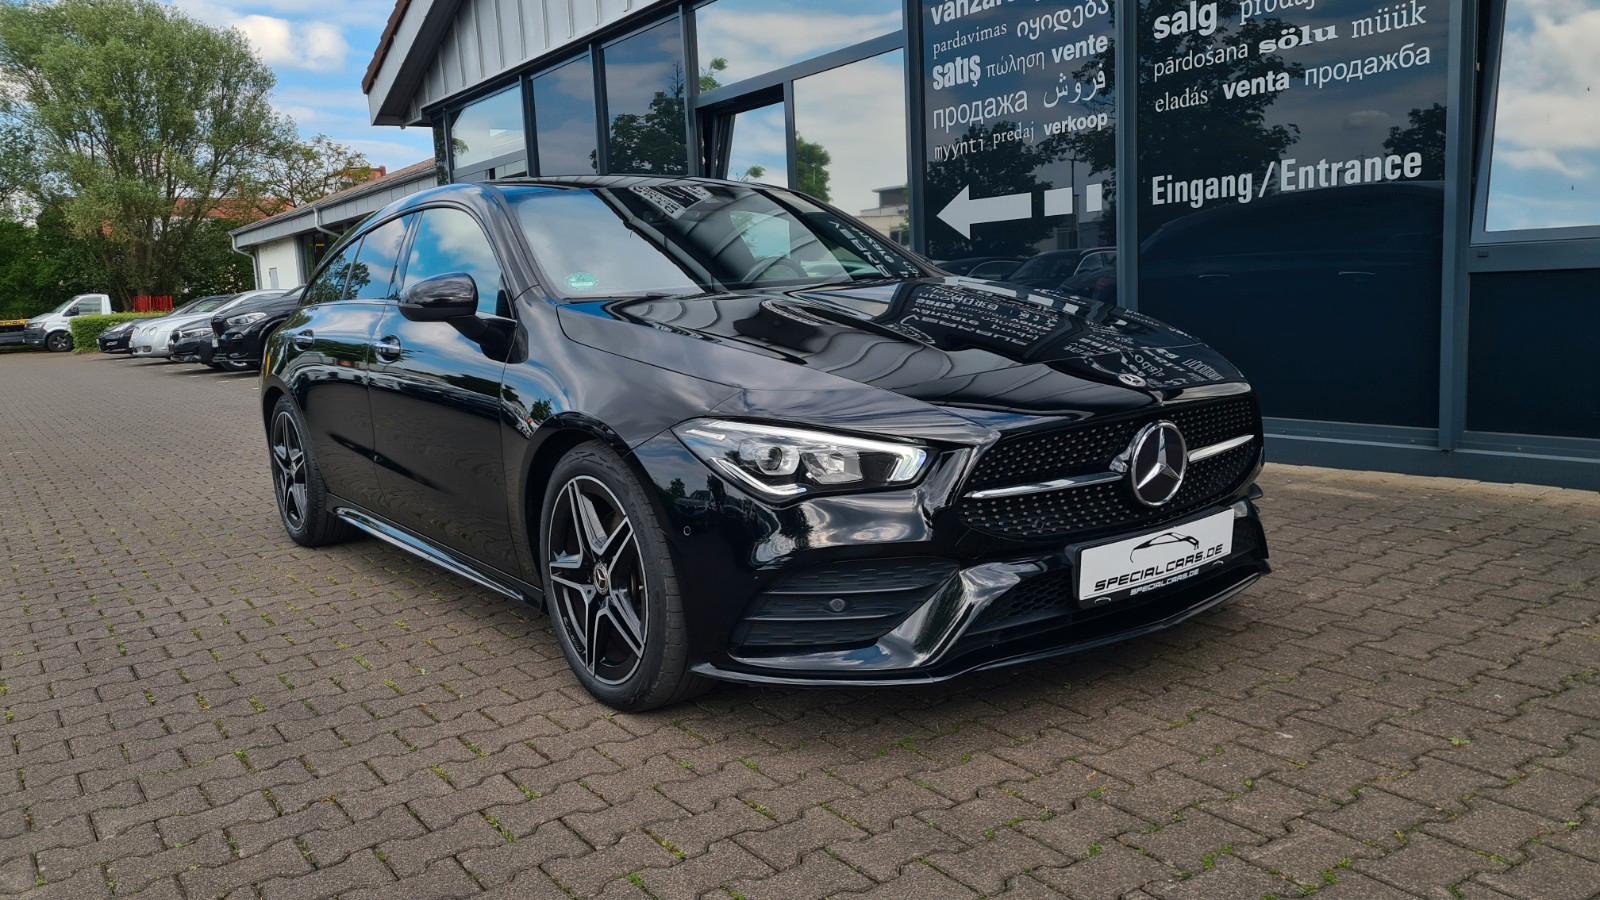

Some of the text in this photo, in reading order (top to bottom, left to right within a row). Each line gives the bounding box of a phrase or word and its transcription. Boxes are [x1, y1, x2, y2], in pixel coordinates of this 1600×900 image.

[933, 23, 1007, 59] pardavimas
[1153, 1, 1217, 39] salg
[1154, 0, 1426, 82] pārdošana sölu müük
[932, 35, 1108, 90] satış πώληση vente
[1155, 43, 1430, 112] eladás venta продажба
[933, 90, 1028, 133] продажа
[934, 112, 1108, 162] myynti predaj verkoop
[1094, 544, 1223, 592] SPECIALCARS.DE
